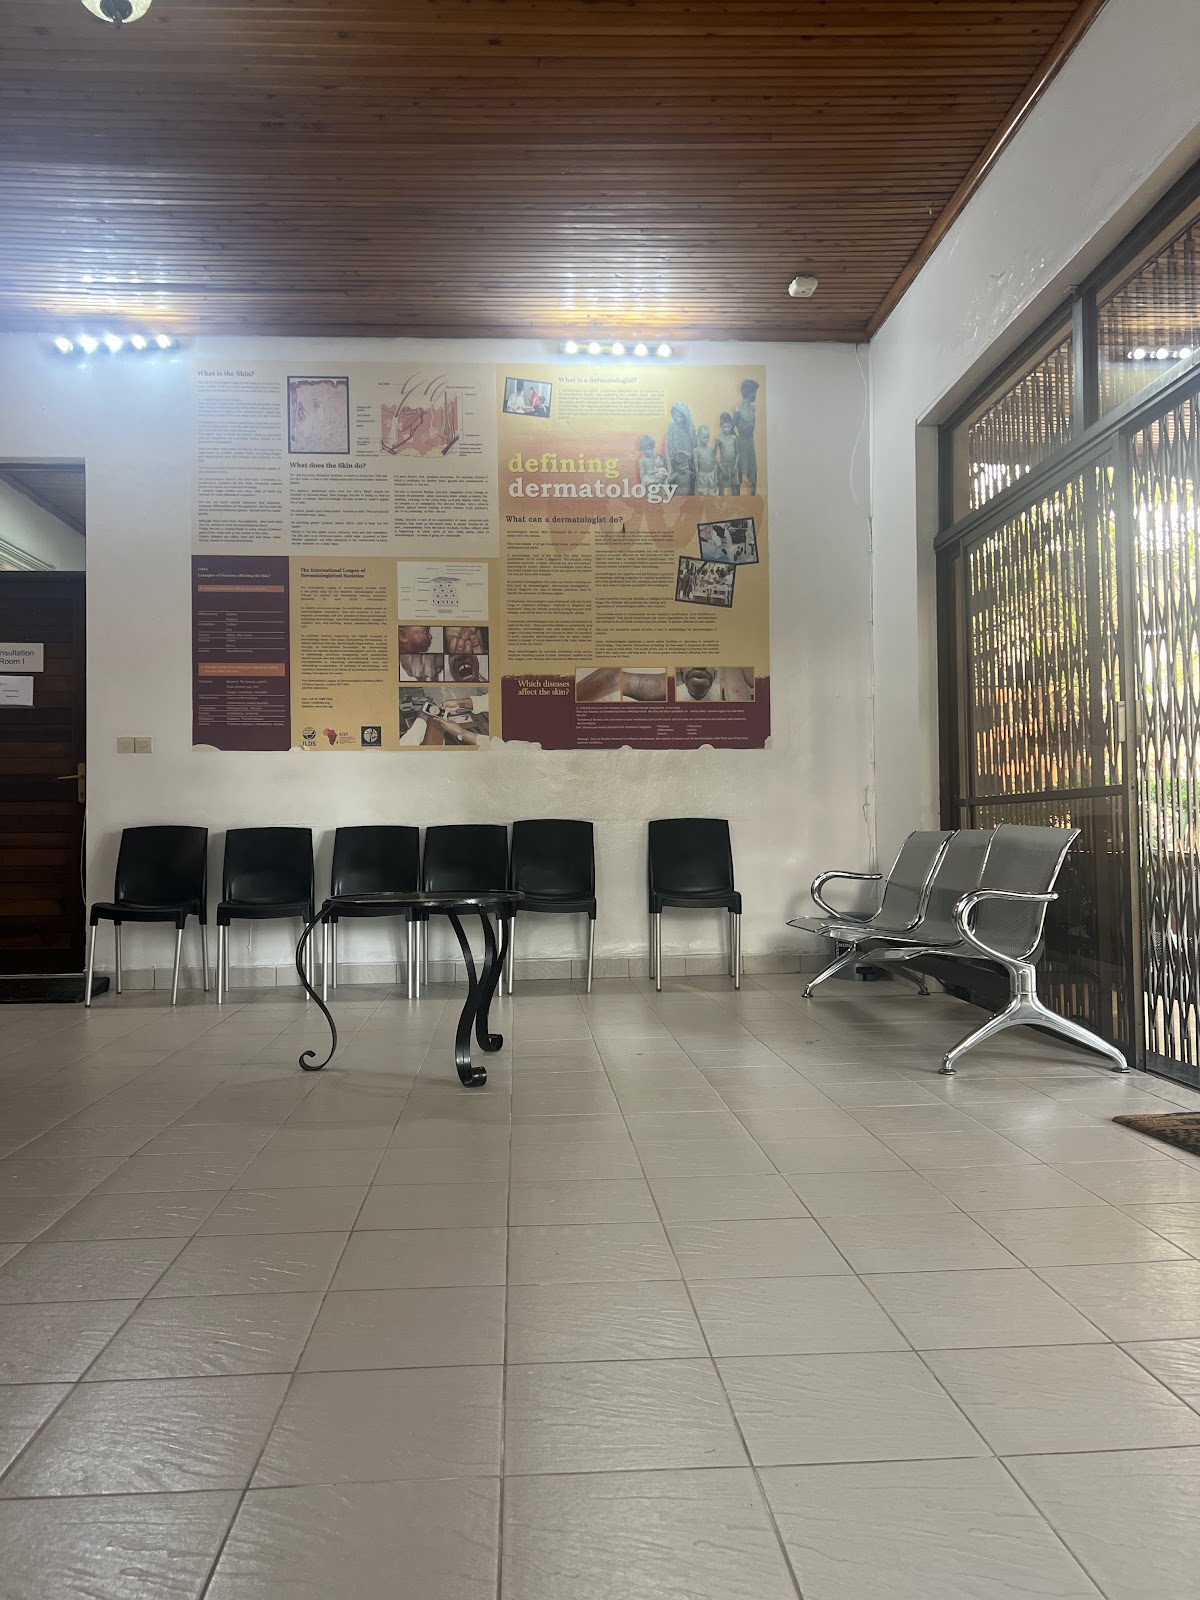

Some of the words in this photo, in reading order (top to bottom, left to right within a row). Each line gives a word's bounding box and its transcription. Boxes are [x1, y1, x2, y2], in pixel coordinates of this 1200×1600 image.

[589, 376, 637, 384] dermatologist?
[507, 452, 620, 479] defining
[508, 477, 678, 504] dermatology
[505, 515, 527, 523] What
[551, 515, 607, 525] dermatologist
[608, 515, 624, 523] do?
[517, 679, 542, 688] Which
[542, 679, 570, 688] diseases
[517, 687, 538, 696] affect
[538, 687, 551, 696] the
[551, 687, 570, 696] skin?
